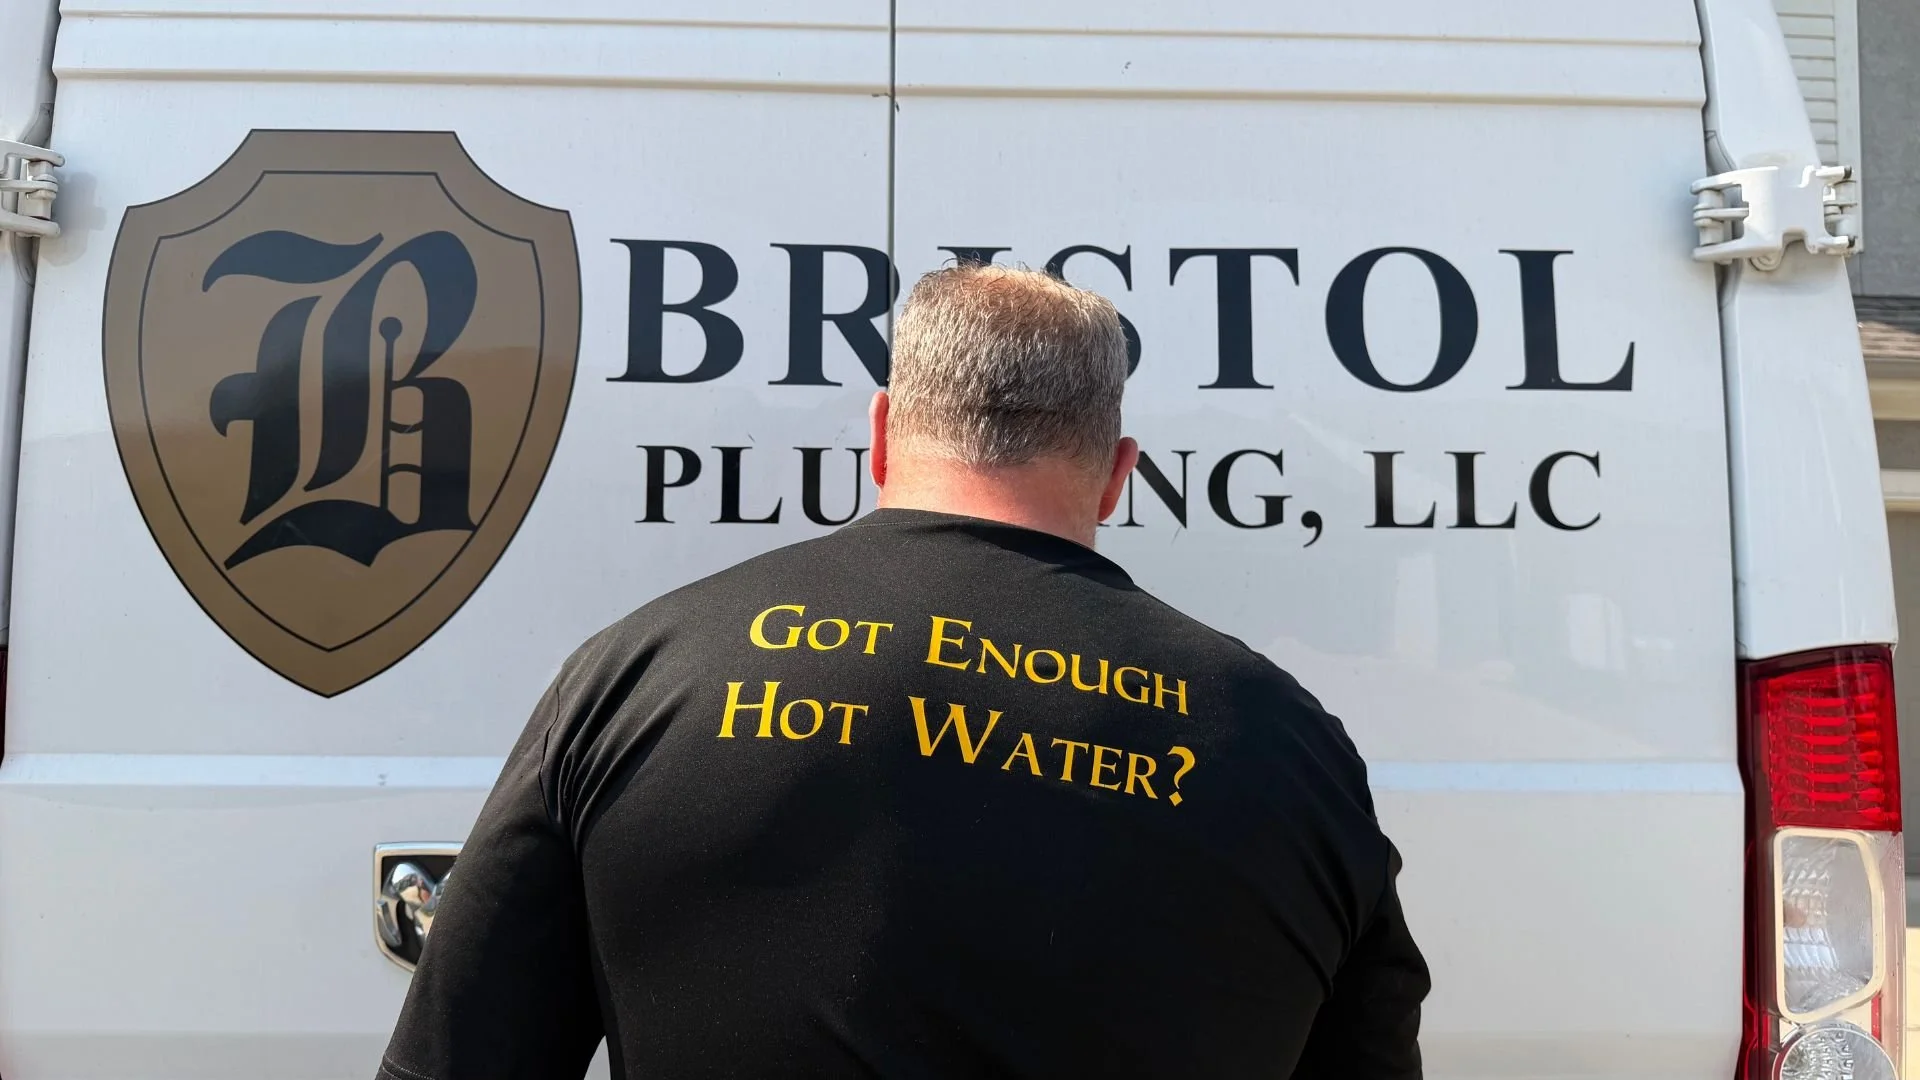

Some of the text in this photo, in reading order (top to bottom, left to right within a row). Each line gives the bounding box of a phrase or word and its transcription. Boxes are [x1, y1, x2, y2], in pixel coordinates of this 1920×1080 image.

[605, 238, 1636, 393] BRTOL
[634, 444, 1602, 548] PLUNG, LLC
[748, 603, 1189, 716] GOT ENOUGH
[717, 680, 1196, 807] HOT WATER?
